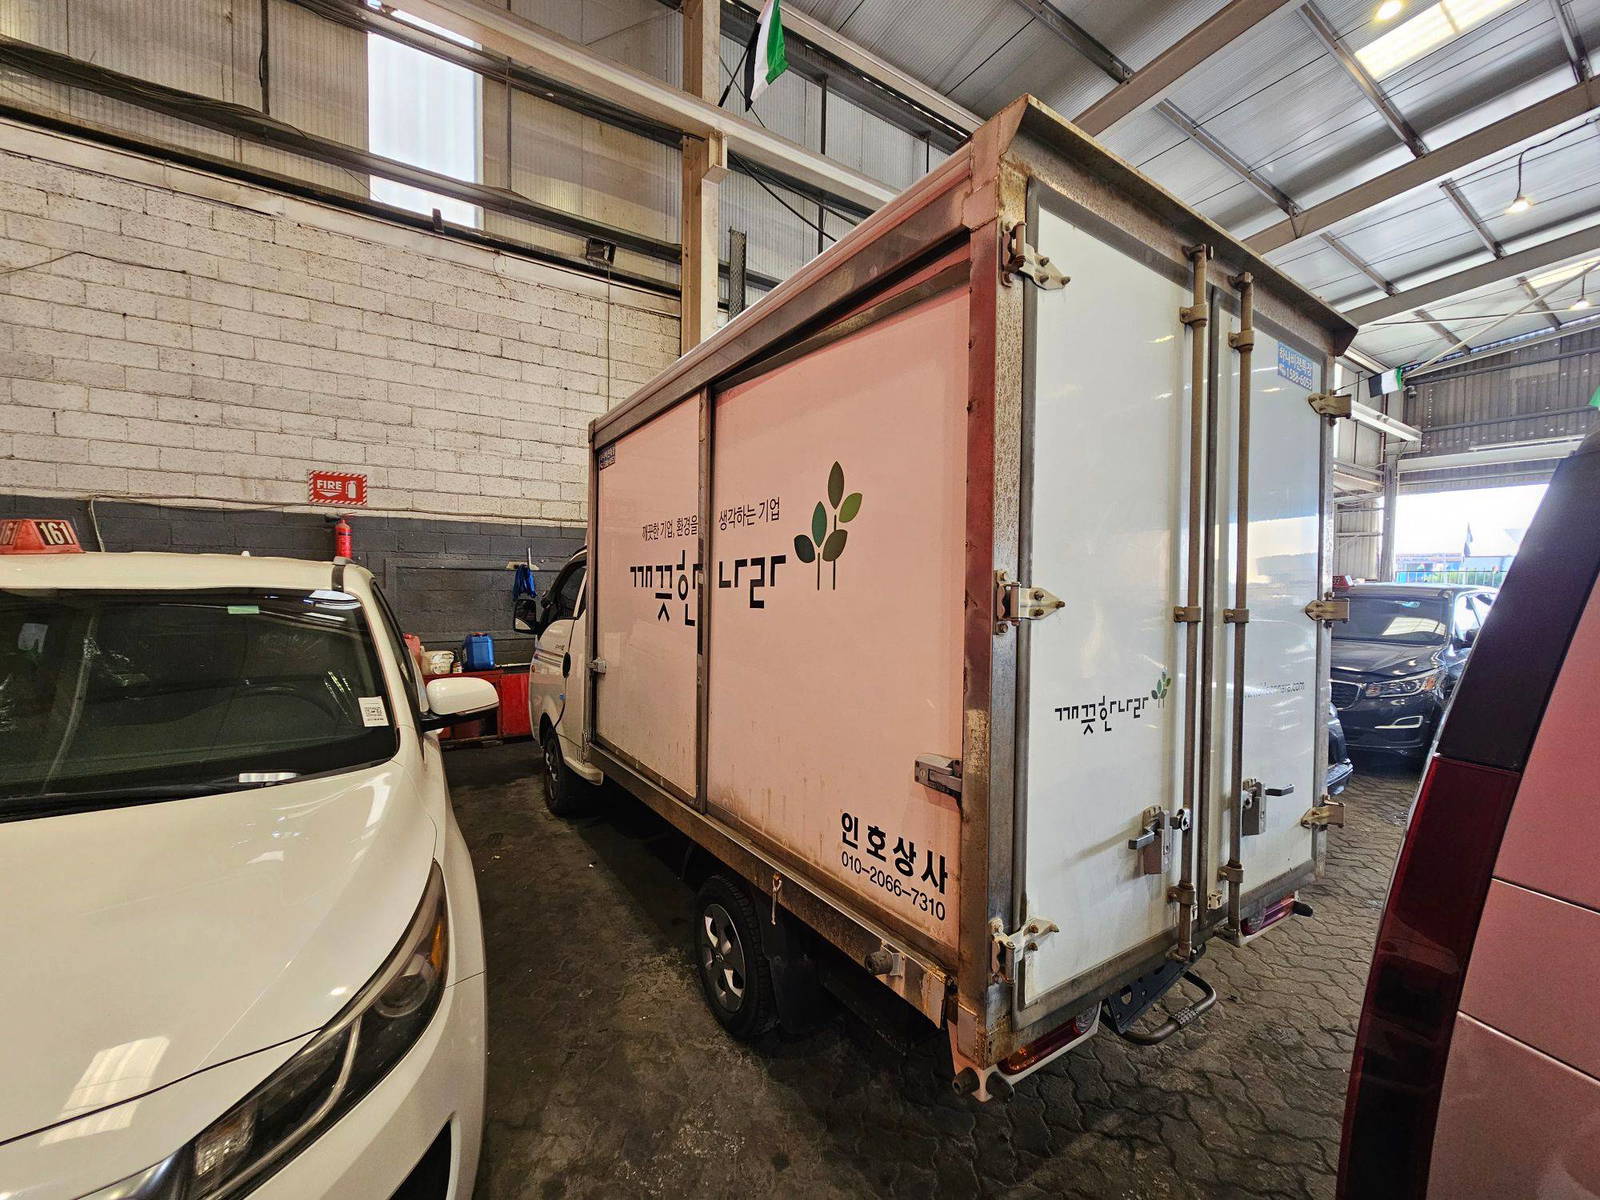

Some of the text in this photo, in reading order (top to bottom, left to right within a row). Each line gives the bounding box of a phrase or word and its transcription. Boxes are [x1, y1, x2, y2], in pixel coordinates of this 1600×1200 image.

[316, 480, 342, 490] FIRE
[39, 522, 75, 545] 161
[677, 515, 699, 537] 환경을
[719, 504, 756, 531] 생각하는
[759, 497, 780, 522] 기업
[841, 812, 948, 895] 인호상사
[841, 851, 946, 921] 010-2066-7310
